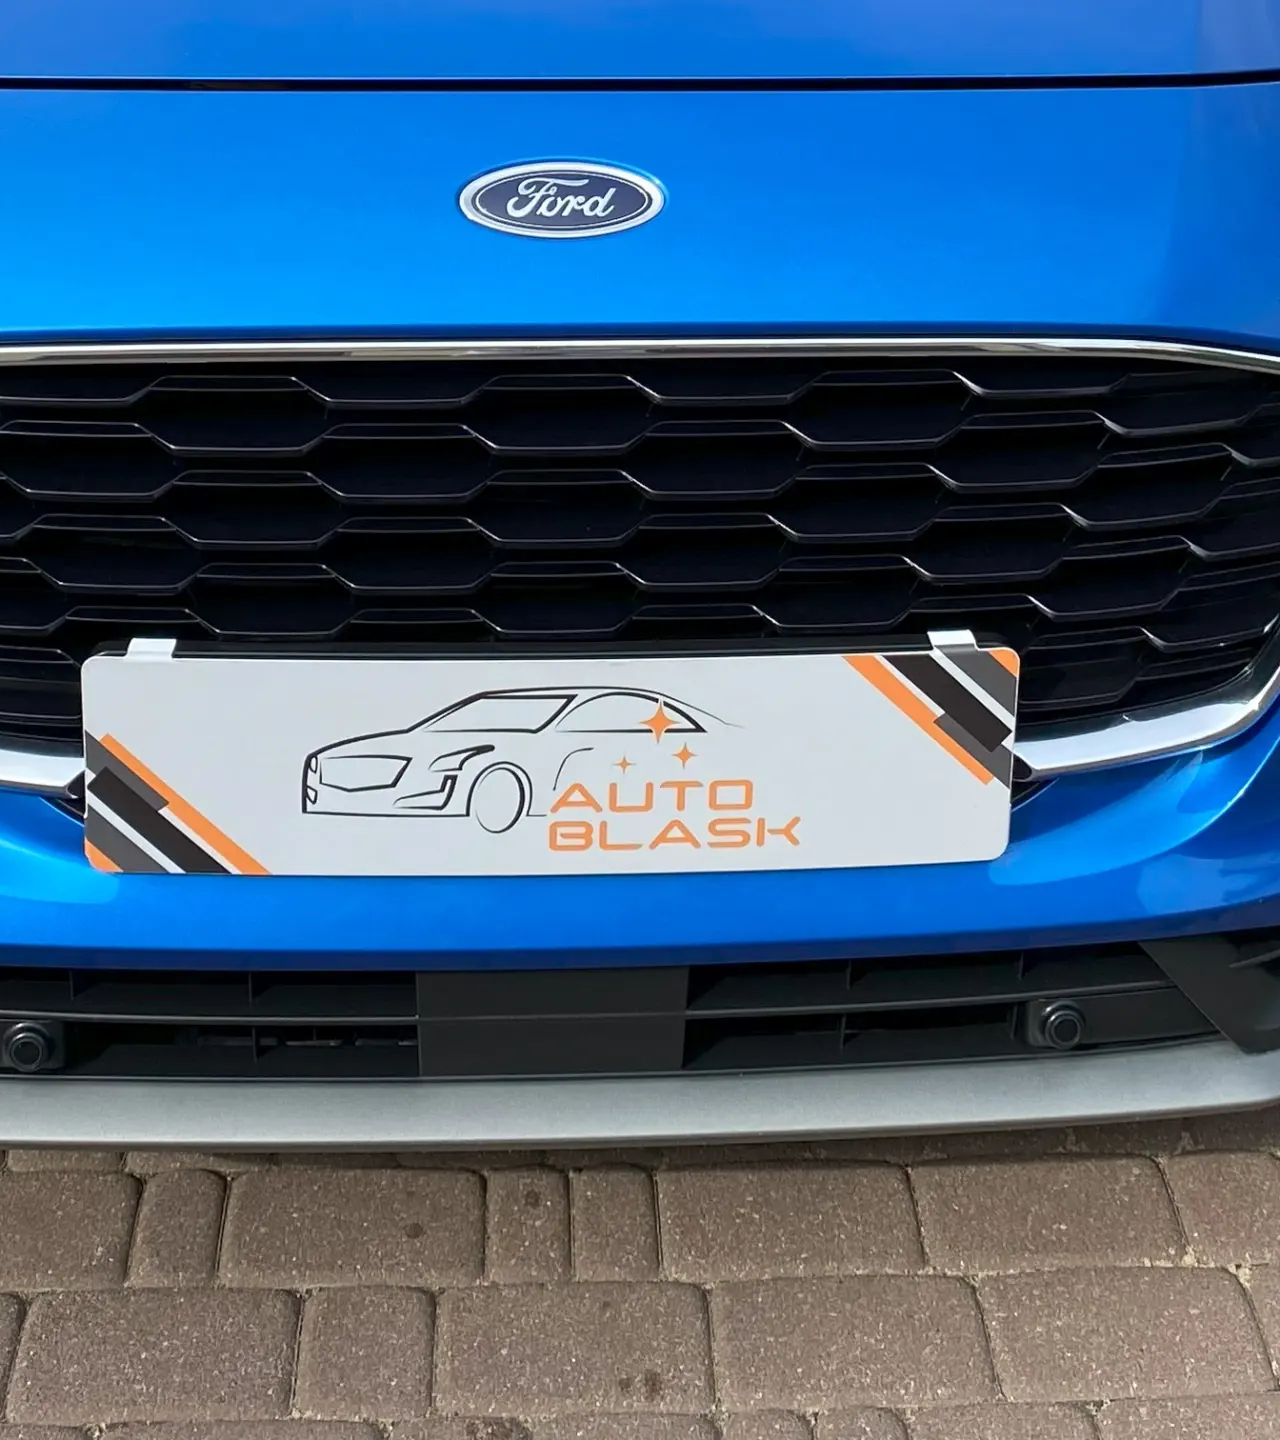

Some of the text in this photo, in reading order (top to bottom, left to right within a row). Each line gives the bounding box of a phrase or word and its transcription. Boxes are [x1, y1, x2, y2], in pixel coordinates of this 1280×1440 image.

[506, 177, 616, 218] Ford
[550, 780, 753, 813] AUTO
[549, 817, 802, 851] BLASK
